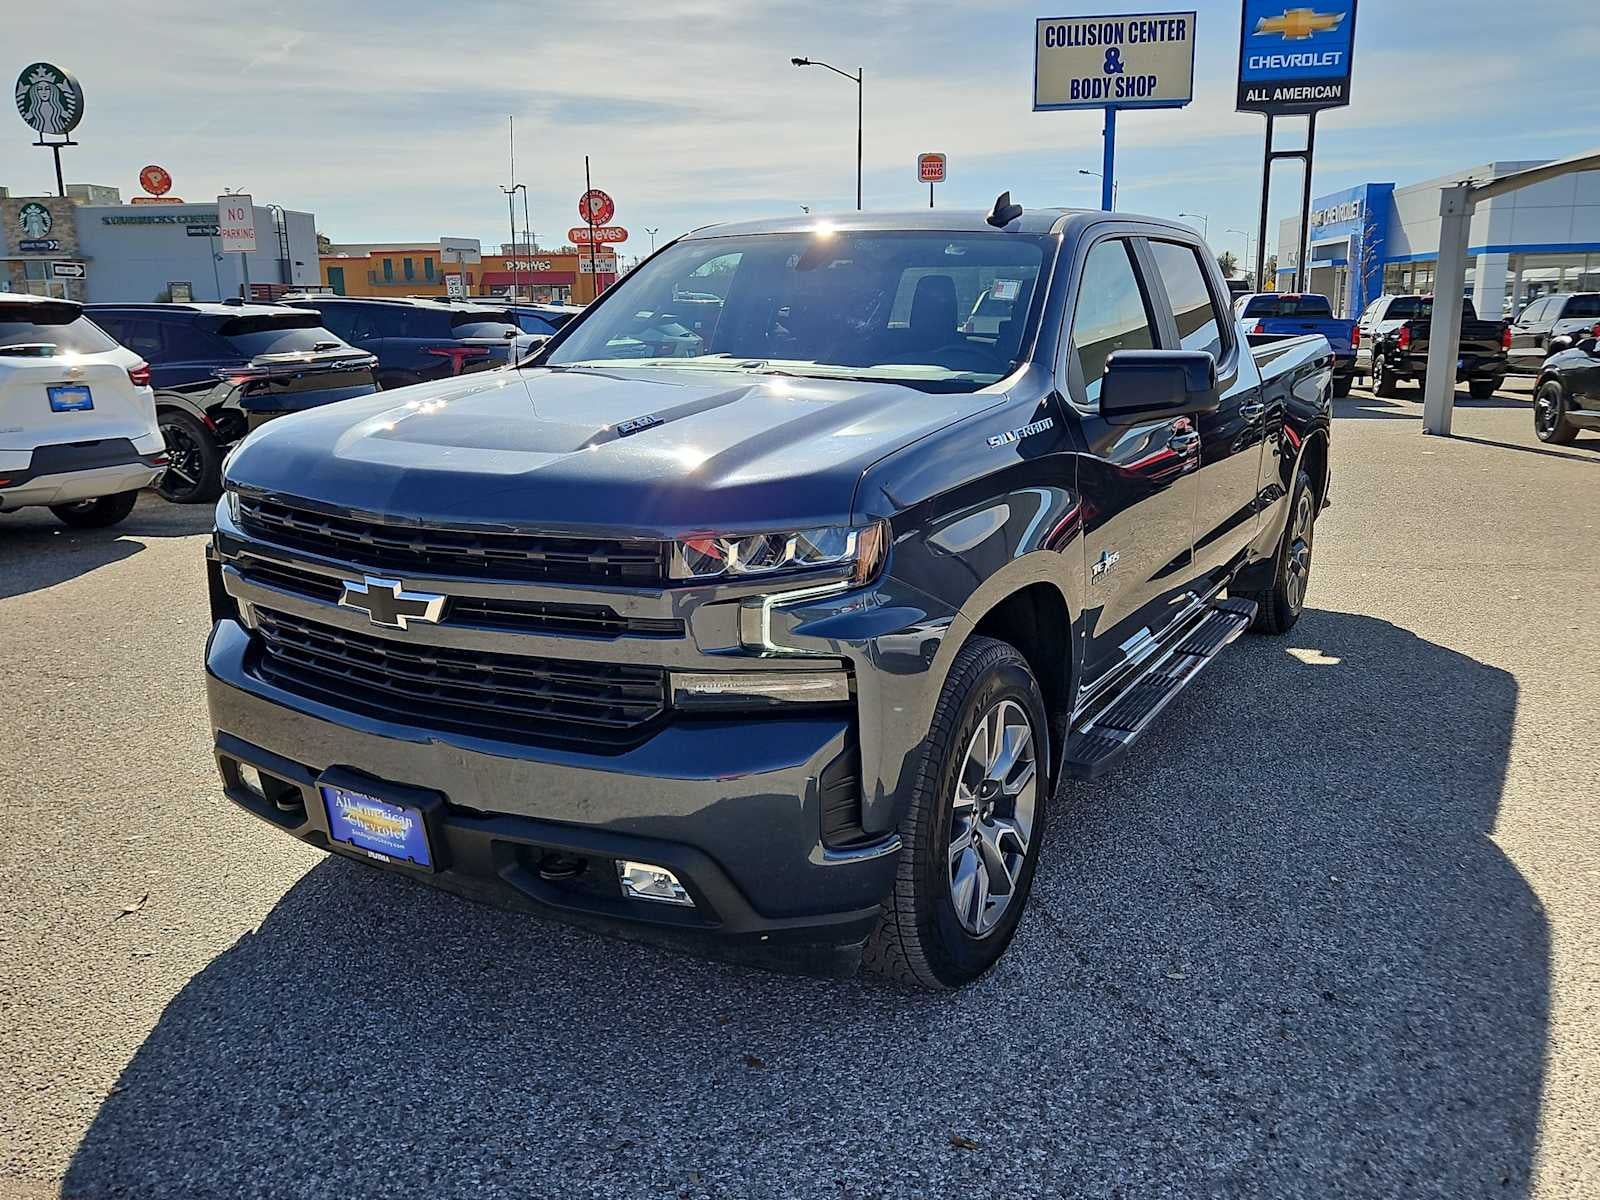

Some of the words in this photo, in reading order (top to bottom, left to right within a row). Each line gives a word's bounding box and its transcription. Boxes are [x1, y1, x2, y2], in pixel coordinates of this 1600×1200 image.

[1045, 23, 1124, 48] COLLISION
[1128, 19, 1186, 44] CENTER
[1104, 47, 1125, 74] &
[1249, 52, 1343, 69] CHEVROLET
[1070, 78, 1112, 100] BODY
[1115, 75, 1157, 98] SHOP
[1246, 89, 1270, 102] ALL
[1273, 85, 1342, 101] AMERICAN
[921, 168, 943, 176] KING
[227, 207, 245, 221] NO
[1324, 199, 1360, 225] CHEVROLET
[222, 228, 256, 240] PARKING
[448, 286, 460, 295] 35
[988, 417, 1054, 449] SILVERADO
[335, 795, 352, 810] All
[348, 813, 408, 841] Chevrolet
